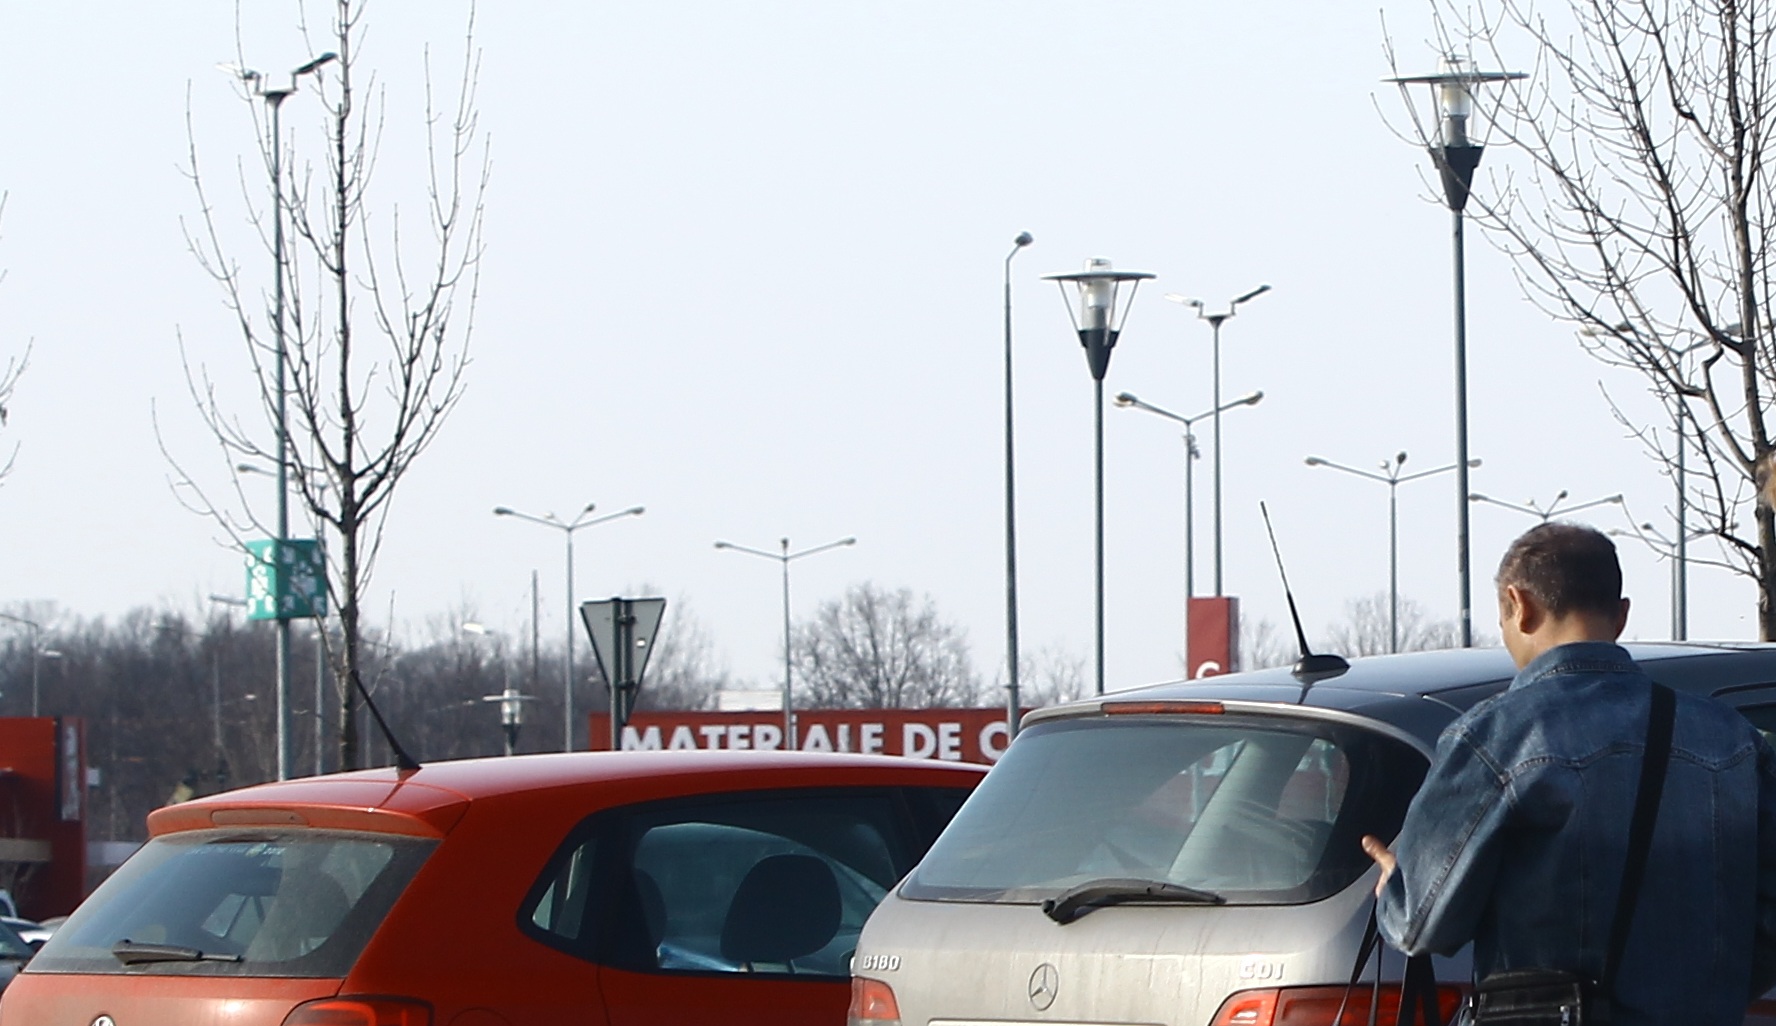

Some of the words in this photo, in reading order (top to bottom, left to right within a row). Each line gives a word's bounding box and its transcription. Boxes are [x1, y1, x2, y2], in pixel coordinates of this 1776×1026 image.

[902, 722, 962, 760] DE
[863, 955, 901, 970] B180
[1240, 959, 1285, 980] CDI
